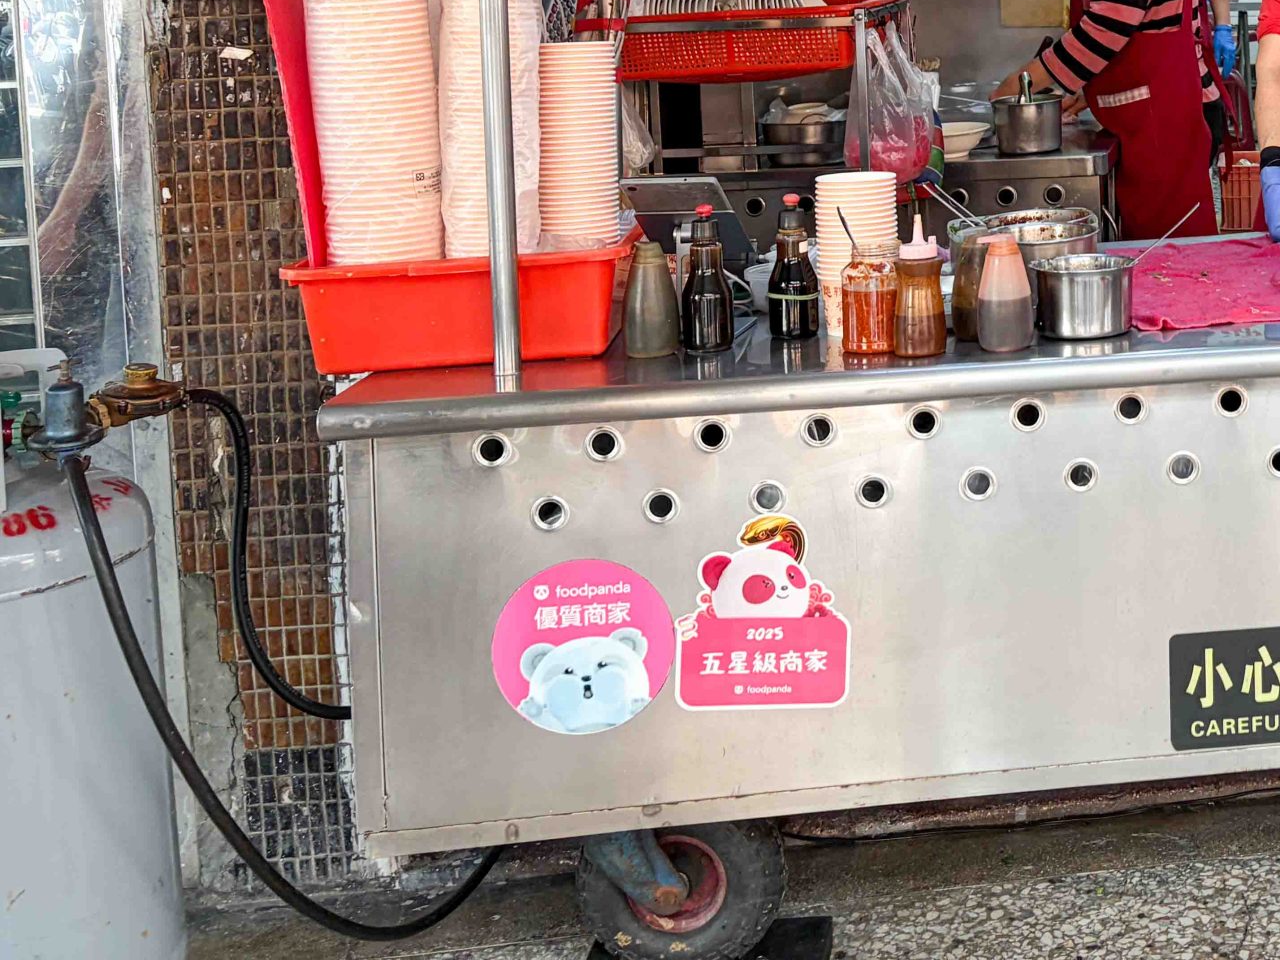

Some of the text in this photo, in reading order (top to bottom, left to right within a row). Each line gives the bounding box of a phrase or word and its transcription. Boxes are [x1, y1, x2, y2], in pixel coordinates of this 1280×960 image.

[555, 581, 631, 599] foodpanda
[533, 601, 632, 630] 優質商家
[746, 626, 784, 641] 2025
[700, 648, 828, 676] 五星級商家
[746, 684, 793, 695] foodpanda
